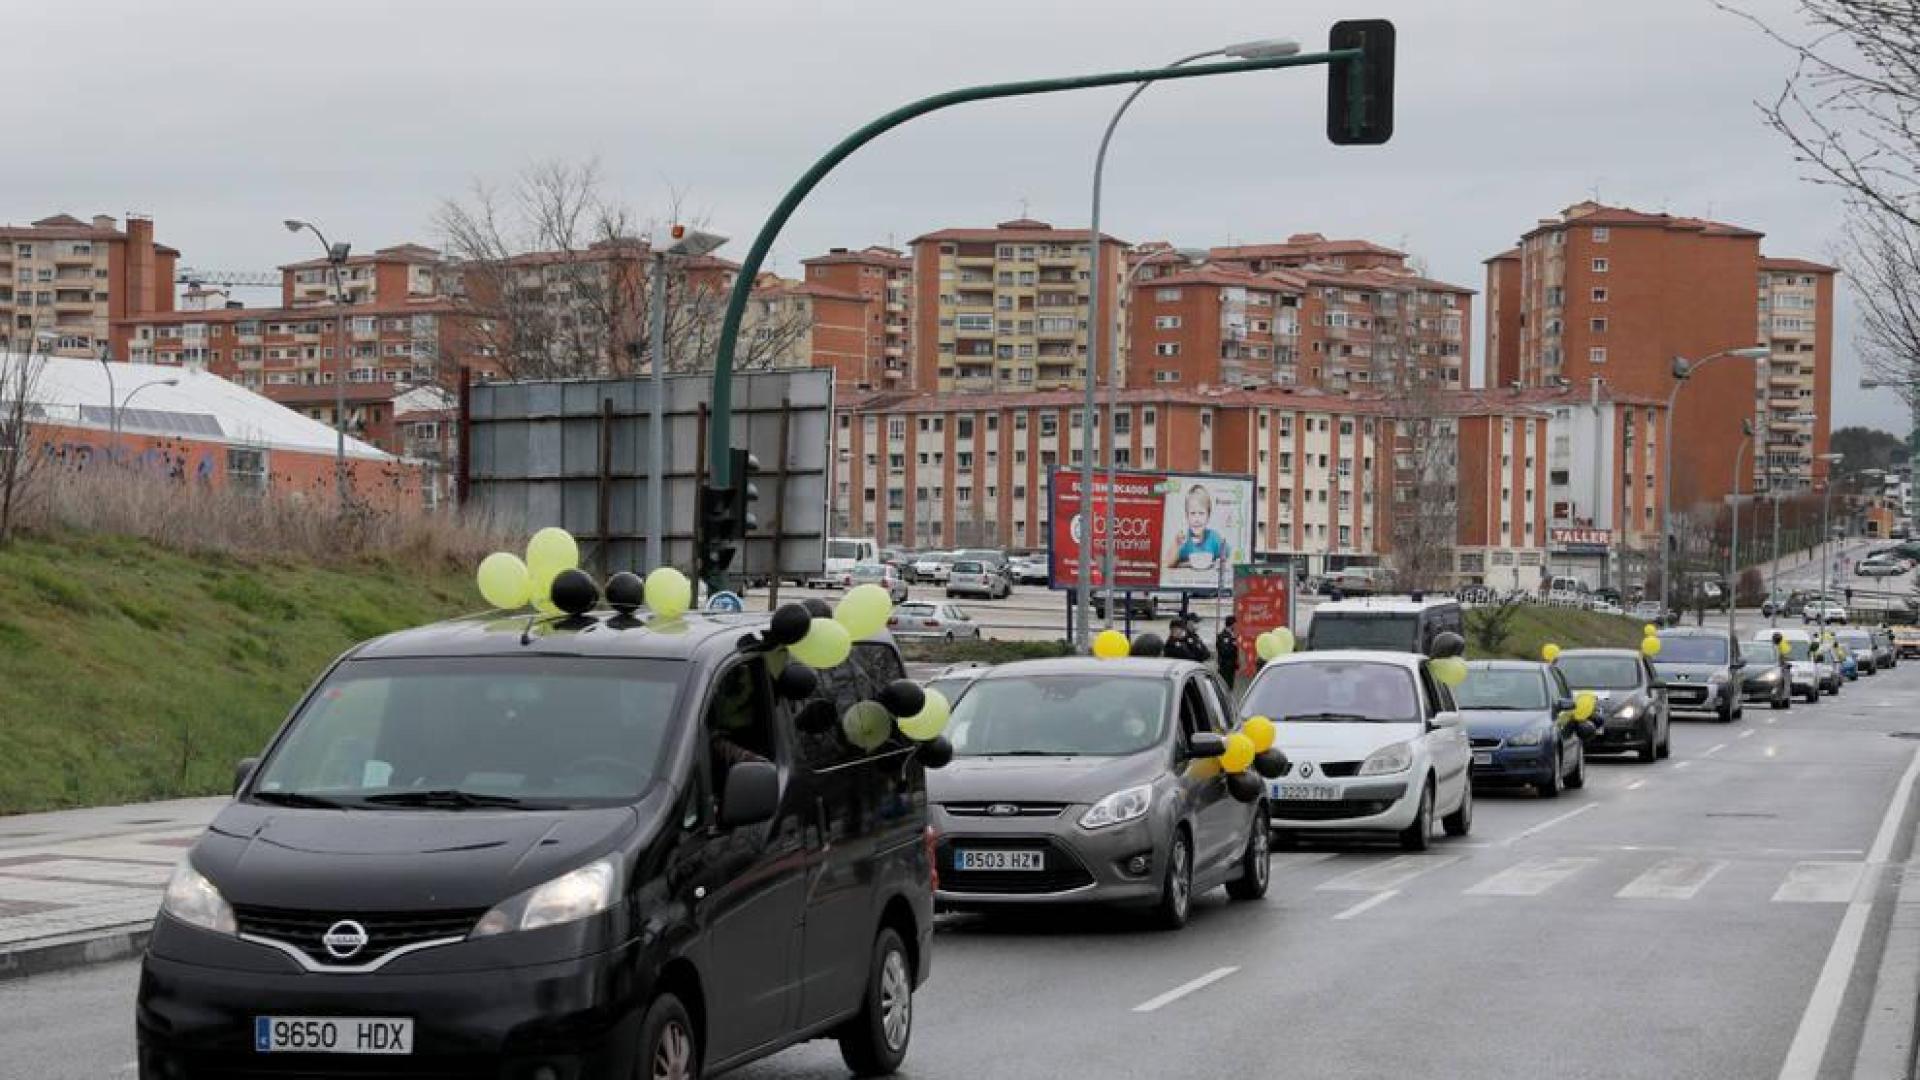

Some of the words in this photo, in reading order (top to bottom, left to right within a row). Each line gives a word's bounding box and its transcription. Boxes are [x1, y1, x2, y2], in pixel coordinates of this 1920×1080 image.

[1555, 530, 1609, 544] TALLER
[965, 852, 1006, 867] 8503
[274, 1021, 338, 1048] 9650
[356, 1023, 405, 1050] HDX
